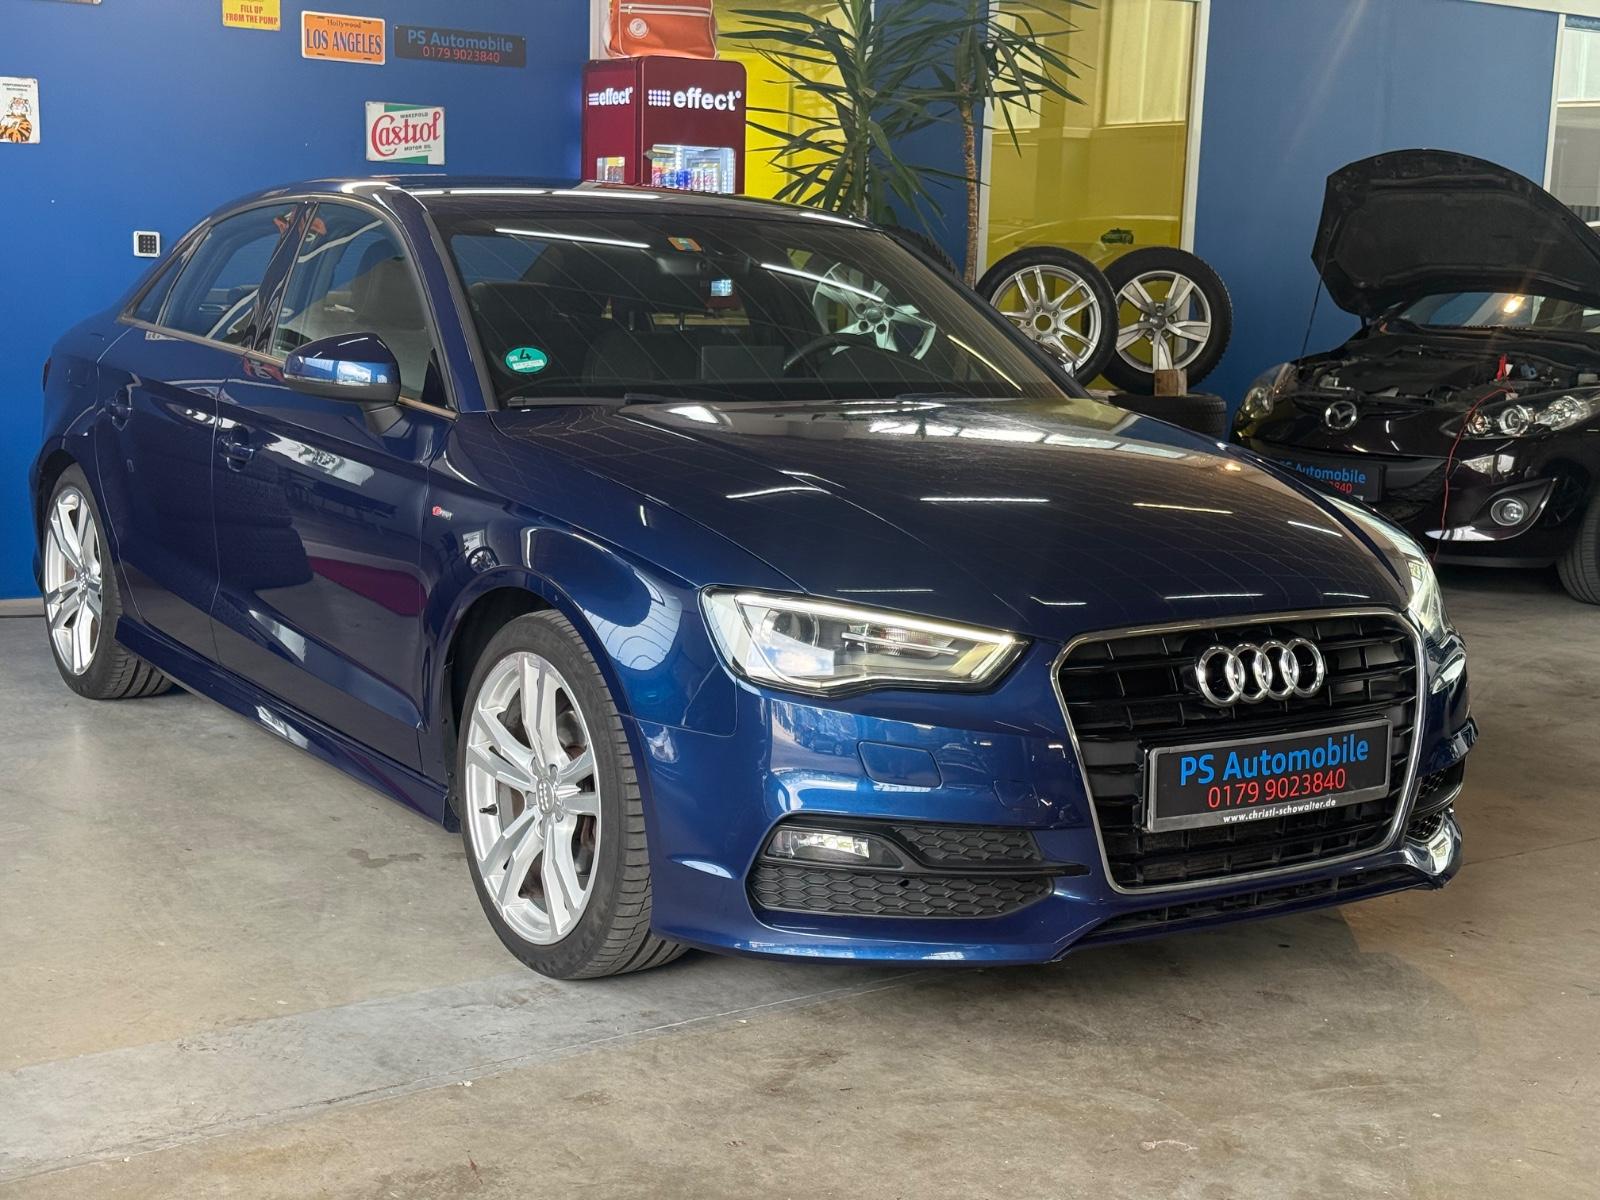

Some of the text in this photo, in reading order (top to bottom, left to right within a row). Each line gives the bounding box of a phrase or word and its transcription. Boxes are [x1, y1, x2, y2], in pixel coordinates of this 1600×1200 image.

[225, 12, 278, 25] FROM THE PUMP
[240, 4, 264, 14] FILL UP
[327, 19, 361, 28] Hollywood
[306, 28, 382, 55] LOS ANGELES
[407, 29, 513, 52] PS Automobile
[422, 46, 500, 63] 0179 9023840
[599, 86, 633, 105] effect
[673, 87, 737, 111] effect
[371, 111, 441, 157] Castrol
[1180, 734, 1369, 785] PS Automobile
[1208, 768, 1346, 808] 0179 9023840
